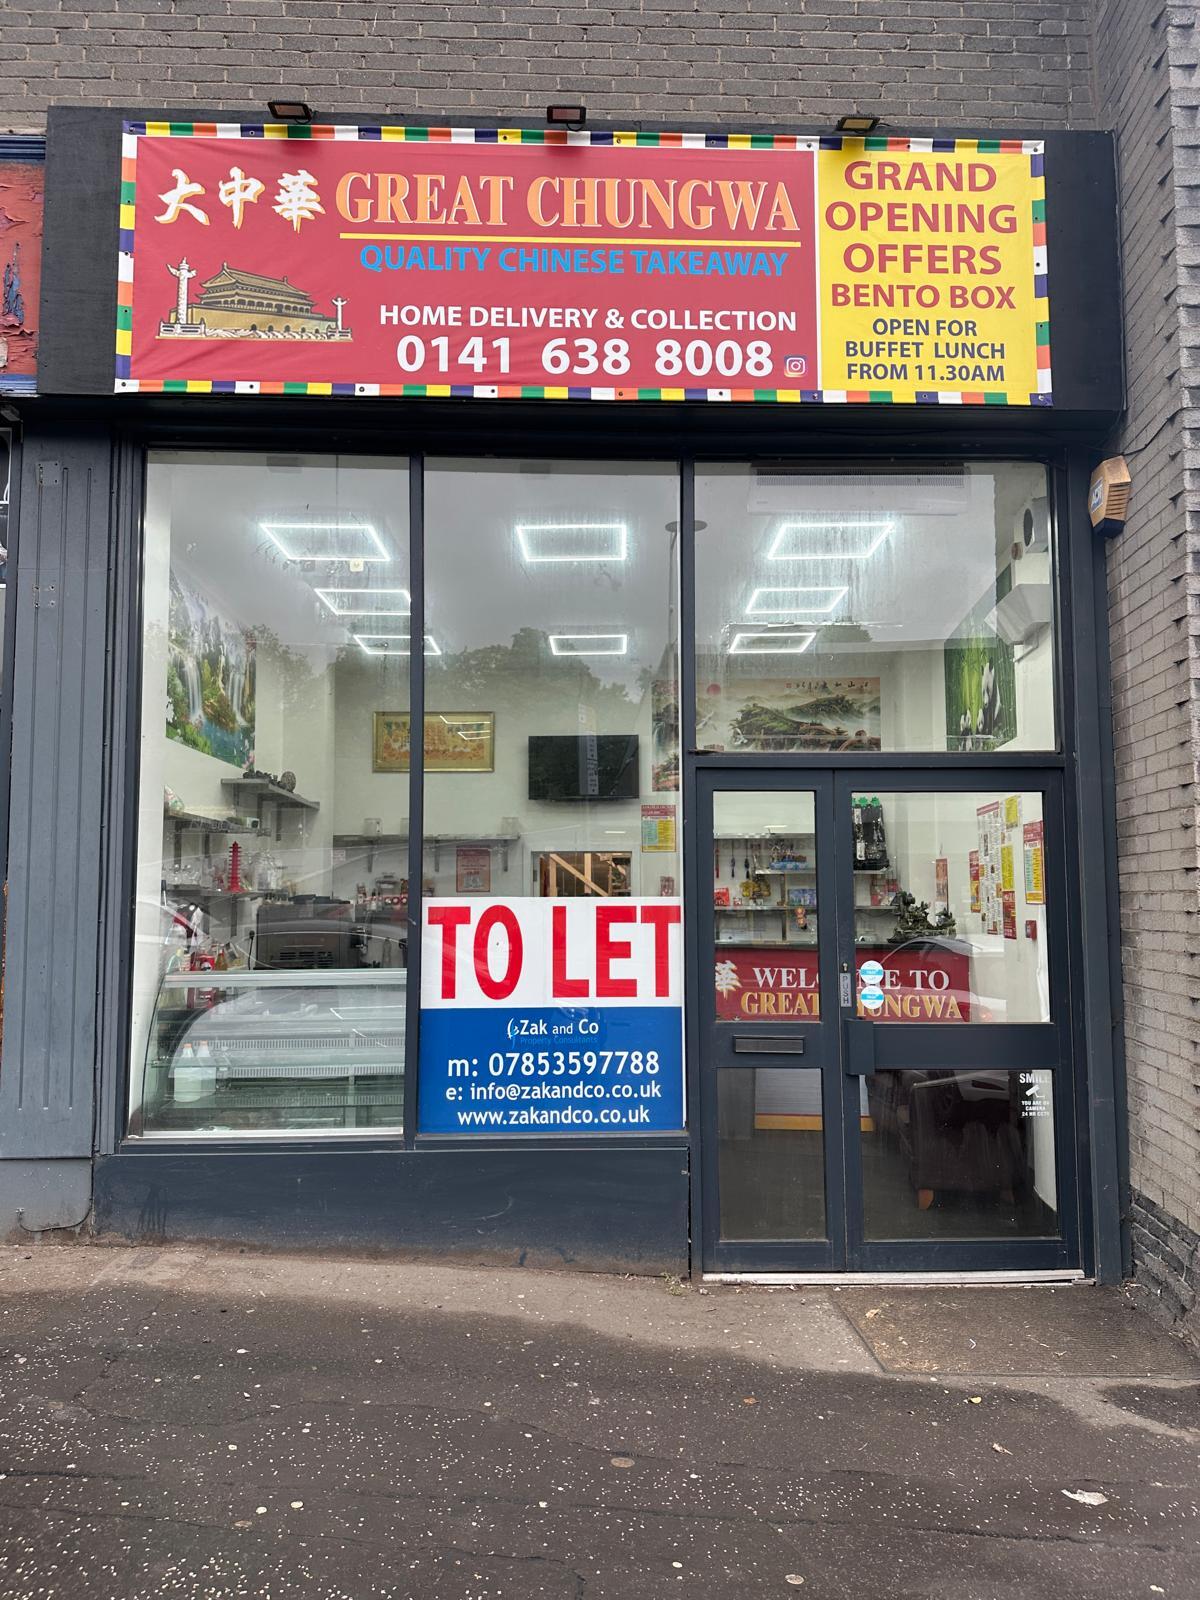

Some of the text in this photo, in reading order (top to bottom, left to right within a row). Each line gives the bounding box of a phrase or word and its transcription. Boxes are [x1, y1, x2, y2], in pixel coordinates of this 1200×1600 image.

[844, 161, 998, 192] GRAND
[154, 166, 326, 234] 大中華
[335, 172, 801, 232] GREAT CHUNGWA
[825, 201, 1018, 234] OPENING
[360, 244, 789, 277] QUALITY CHINESE TAKEAWAY
[843, 242, 1003, 275] OFFERS
[831, 283, 1017, 310] BENTO BOX
[380, 304, 798, 332] HOME DELIVERY & COLLECTION
[872, 318, 978, 337] OPEN FOR
[396, 335, 774, 377] 0141 638 8008
[845, 340, 1006, 360] BUFFET LUNCH
[847, 363, 1006, 382] FROM 11.30AM
[428, 904, 681, 1000] TO LET
[752, 967, 902, 991] WELE
[909, 970, 950, 990] TO
[842, 975, 850, 1005] PUSH
[741, 991, 820, 1016] GREAT
[519, 1018, 599, 1035] Zak and Co
[448, 1051, 660, 1078] m: 07853597788
[445, 1080, 662, 1101] e: info@zakandco.co.uk
[457, 1104, 651, 1126] www.zakandco.co.uk
